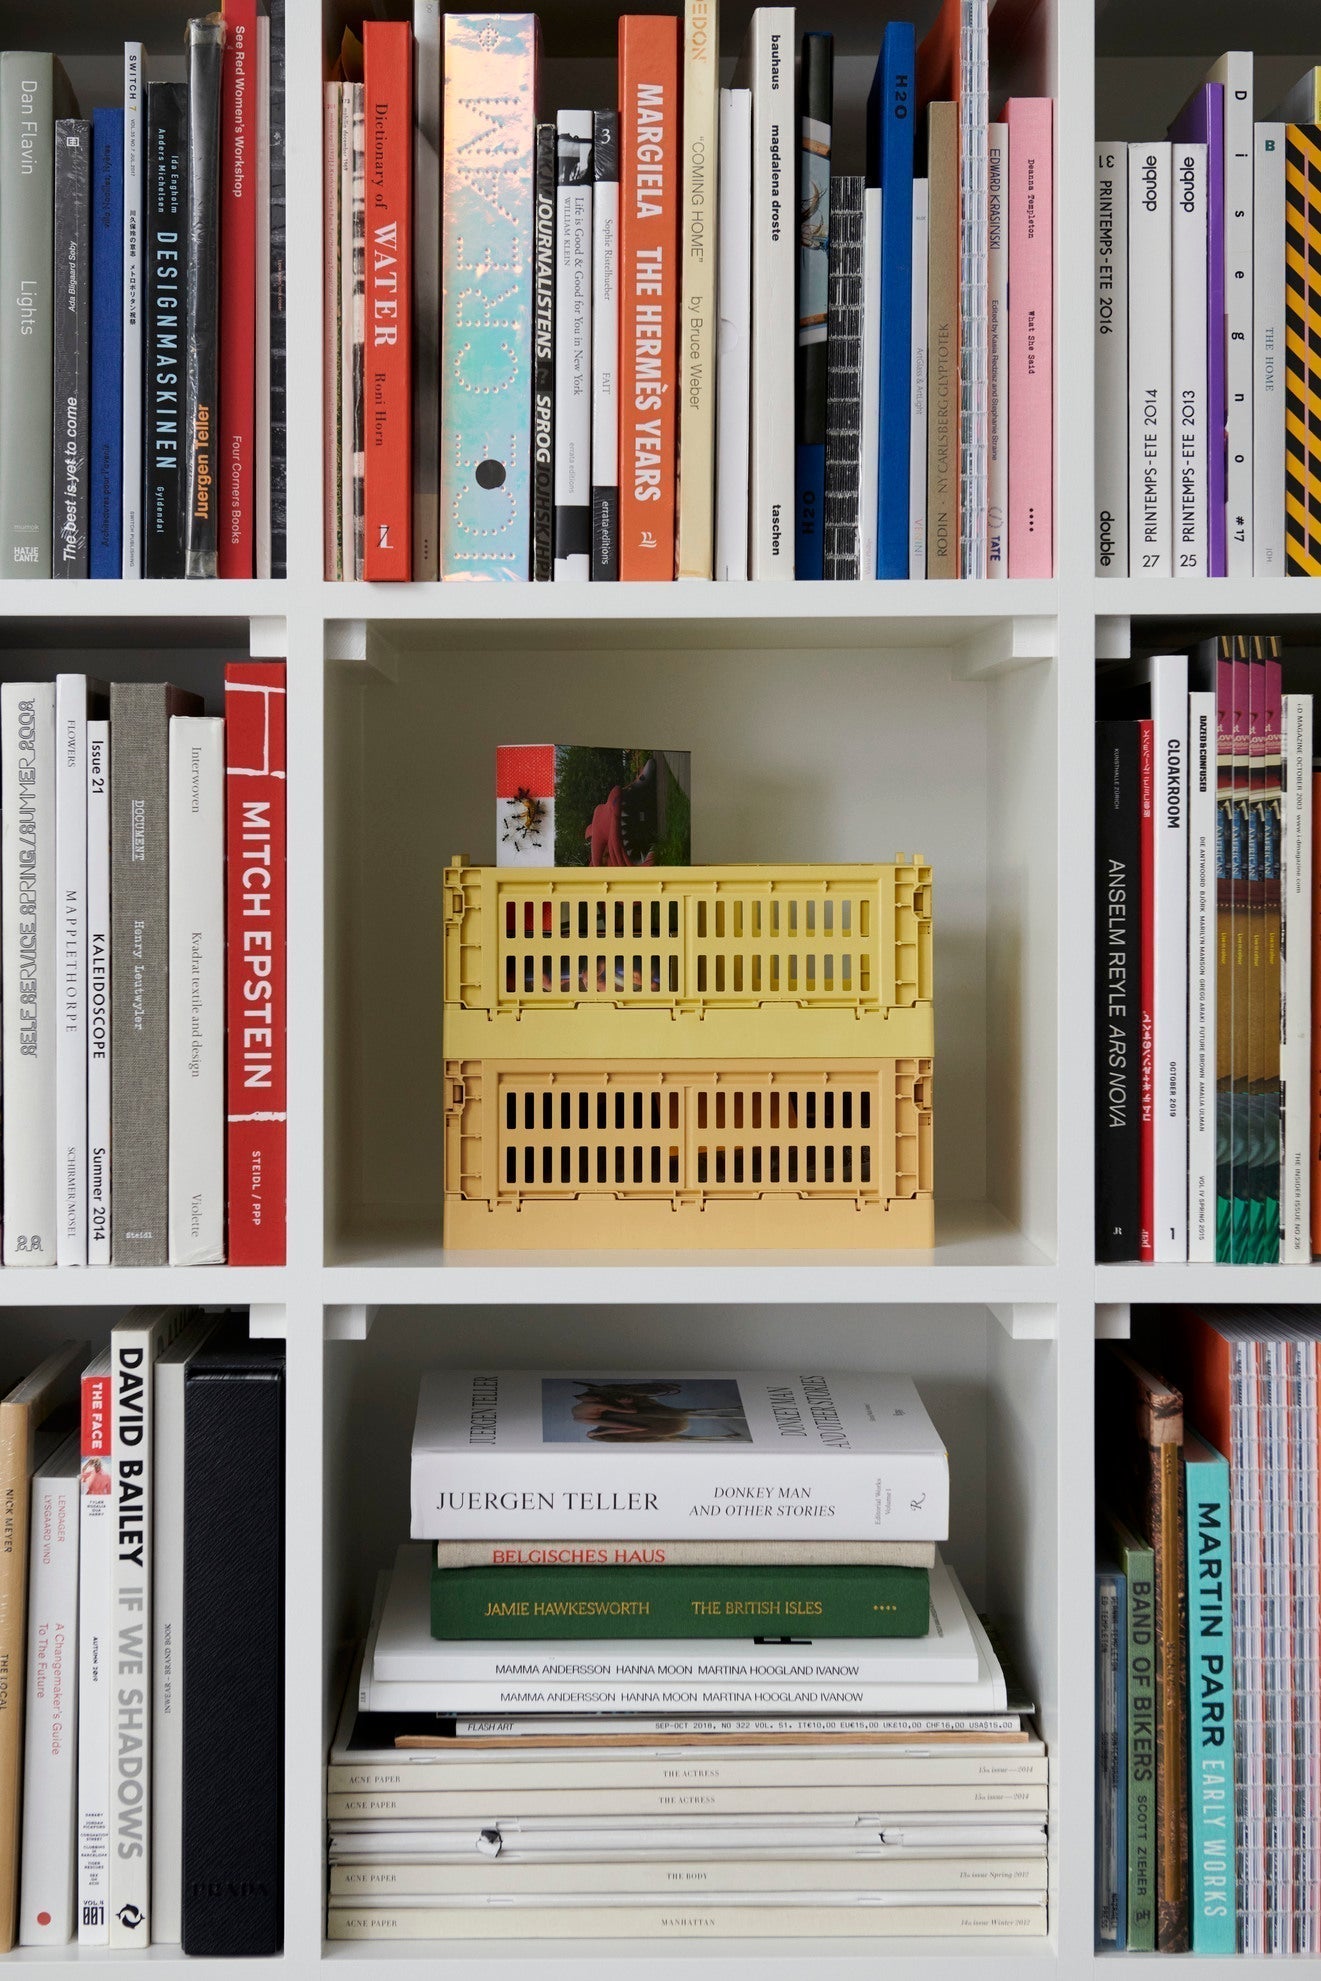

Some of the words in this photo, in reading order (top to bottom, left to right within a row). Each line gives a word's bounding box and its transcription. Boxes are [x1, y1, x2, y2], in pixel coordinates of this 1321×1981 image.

[236, 26, 245, 48] See
[235, 52, 245, 75] Red
[772, 35, 781, 90] bauhaus
[21, 80, 37, 113] Dan
[235, 78, 245, 133] Women's
[895, 75, 907, 119] H2O
[21, 121, 37, 174] Flavin
[233, 136, 244, 197] Workshop
[372, 104, 388, 187] Dictionary
[637, 84, 663, 218] MARGIELA
[770, 125, 781, 196] magdalena
[990, 149, 1000, 191] EDWARD
[1142, 156, 1157, 212] double
[170, 174, 179, 213] Engholm
[375, 194, 388, 209] of
[603, 219, 613, 247] Sophie
[772, 201, 781, 241] droste
[990, 195, 1001, 249] KRASIŃSKI
[1027, 195, 1035, 238] Templeton
[374, 222, 397, 347] WATER
[537, 194, 552, 358] JOURNALISTENS
[604, 250, 613, 300] Ristelhueber
[636, 247, 662, 295] THE
[16, 281, 37, 334] Lights
[688, 296, 703, 313] by
[1100, 297, 1112, 334] 2016
[156, 232, 178, 469] DESIGNMASKINEN
[635, 305, 668, 410] HERMÈS
[690, 319, 702, 359] Bruce
[937, 324, 949, 397] GLYPTOTEK
[1265, 328, 1273, 350] THE
[375, 373, 386, 404] Roni
[602, 372, 611, 394] FAIT
[690, 364, 702, 410] Weber
[1265, 357, 1273, 391] HOME
[67, 397, 77, 436] come
[196, 404, 209, 449] Teller
[375, 411, 386, 446] Horn
[537, 395, 551, 462] SPROG
[1144, 389, 1157, 425] 2014
[64, 442, 76, 455] to
[232, 436, 242, 460] Four
[937, 400, 949, 473] CARLSBERG
[65, 459, 80, 481] yet
[634, 419, 661, 501] YEARS
[64, 486, 76, 497] is
[195, 455, 211, 518] Juergen
[232, 463, 241, 507] Corners
[937, 476, 948, 493] NY
[64, 501, 76, 530] best
[156, 487, 164, 532] Gyldendal
[232, 510, 241, 544] Books
[602, 501, 610, 526] errata
[772, 505, 782, 555] taschen
[63, 536, 76, 561] The
[602, 529, 611, 564] editions
[936, 512, 947, 557] RODIN
[990, 535, 1000, 561] TATE
[1100, 511, 1114, 566] double
[67, 720, 76, 767] FLOWERS
[92, 740, 104, 774] Issue
[92, 778, 104, 794] 21
[192, 747, 201, 813] Interwoven
[1167, 740, 1180, 828] CLOAKROOM
[132, 800, 144, 861] DOCUMENT
[242, 802, 270, 915] MITCH
[1108, 860, 1125, 945] ANSELM
[66, 890, 77, 1032] MAPPLETHORPE
[134, 921, 144, 958] Henry
[93, 934, 105, 1059] KALEIDOSCOPE
[133, 966, 144, 1030] Leutwyler
[1109, 952, 1125, 1016] REYLE
[244, 932, 272, 1087] EPSTEIN
[1109, 1025, 1126, 1067] ARS
[1109, 1072, 1126, 1127] NOVA
[93, 1148, 105, 1201] Summer
[252, 1151, 260, 1190] STEIDL
[93, 1207, 105, 1241] 2014
[192, 1194, 202, 1237] Violette
[92, 1383, 102, 1409] THE
[119, 1348, 144, 1446] DAVID
[92, 1413, 102, 1449] FACE
[118, 1460, 144, 1567] BAILEY
[437, 1492, 553, 1510] JUERGEN
[563, 1492, 659, 1510] TELLER
[690, 1506, 720, 1517] AND
[726, 1505, 772, 1517] OTHER
[777, 1505, 835, 1517] STORIES
[714, 1487, 774, 1498] DONKEY
[778, 1487, 812, 1498] MAN
[57, 1495, 65, 1542] LENDAGER
[493, 1550, 608, 1564] BELGISCHES
[615, 1550, 665, 1563] HAUS
[1198, 1503, 1223, 1636] MARTIN
[119, 1588, 143, 1611] IF
[485, 1602, 529, 1616] JAMIE
[534, 1602, 649, 1615] HAWKESWORTH
[692, 1602, 720, 1614] THE
[726, 1602, 780, 1614] BRITISH
[785, 1602, 822, 1614] ISLES
[1132, 1581, 1152, 1645] BAND
[38, 1624, 48, 1635] To
[38, 1639, 47, 1658] The
[118, 1624, 142, 1674] WE
[37, 1662, 47, 1698] Future
[496, 1665, 539, 1674] MAMMA
[542, 1665, 610, 1674] ANDERSSON
[616, 1665, 654, 1674] HANNA
[658, 1665, 692, 1674] MOON
[698, 1665, 747, 1675] MARTINA
[750, 1665, 813, 1675] HOOGLAND
[816, 1665, 859, 1676] IVANOW
[1132, 1657, 1151, 1687] OF
[1201, 1655, 1224, 1747] PARR
[52, 1723, 62, 1755] Guide
[468, 1723, 496, 1731] FLASH
[497, 1723, 514, 1731] ART
[1133, 1697, 1153, 1781] BIKERS
[118, 1689, 143, 1859] SHADOWS
[1202, 1760, 1226, 1828] EARLY
[1137, 1795, 1147, 1839] SCOTT
[1137, 1847, 1147, 1896] ZIEHER
[1203, 1840, 1227, 1917] WORKS
